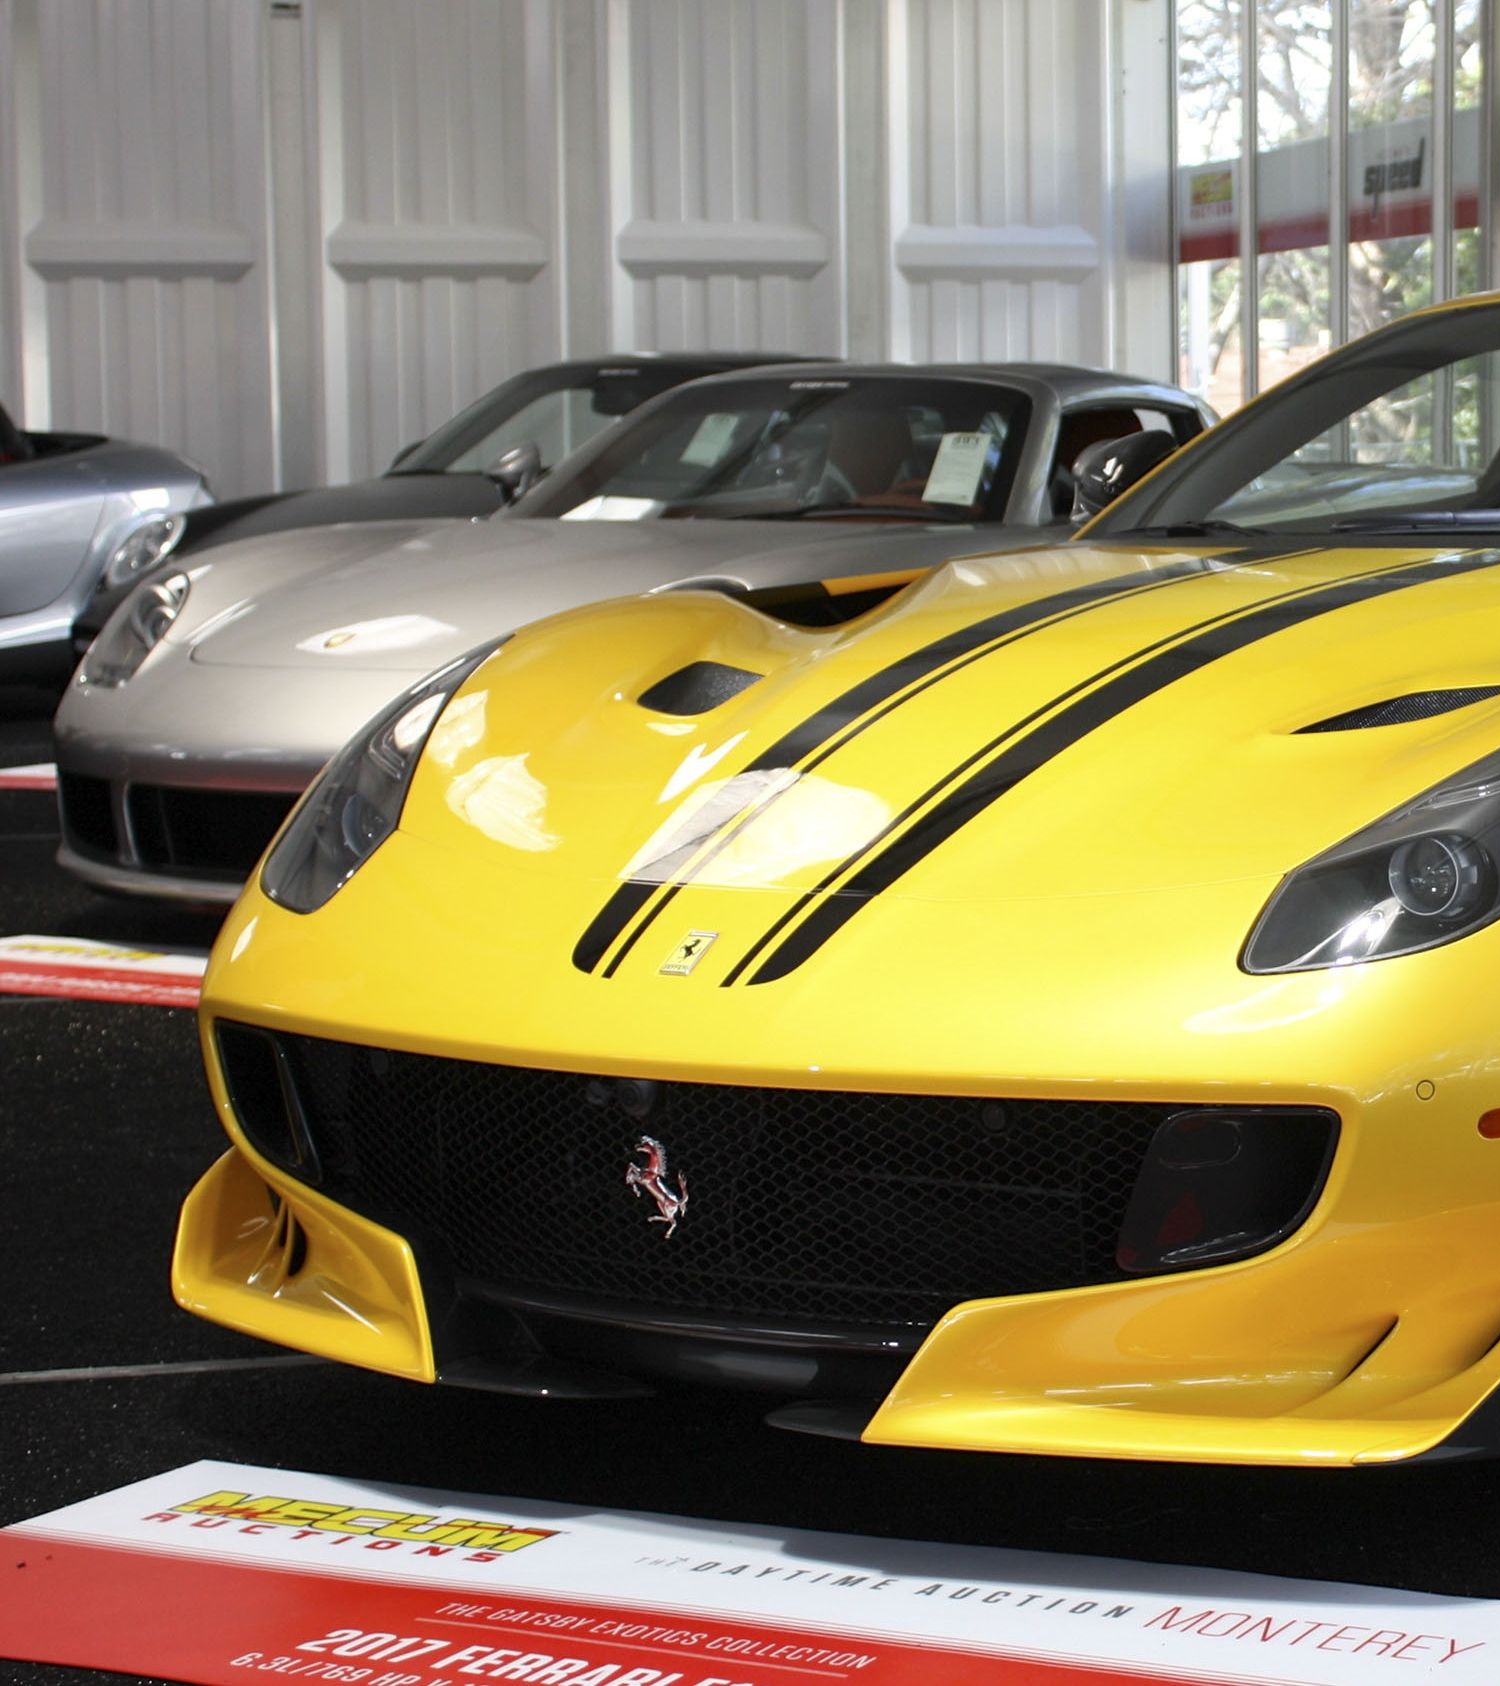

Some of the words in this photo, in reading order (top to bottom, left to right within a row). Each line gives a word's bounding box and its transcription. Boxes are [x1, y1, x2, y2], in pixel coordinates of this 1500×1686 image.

[143, 1511, 505, 1563] AUCTIONS
[168, 1490, 560, 1553] MECUM
[435, 1602, 492, 1618] THE
[487, 1608, 595, 1631] GATSBY
[589, 1620, 709, 1647] EXOTICS
[705, 1636, 877, 1669] COLLECTION
[689, 1561, 899, 1590] DAYTIME
[914, 1583, 1134, 1618] AUCTION
[1143, 1606, 1486, 1664] MONTEREY
[229, 1652, 374, 1683] 6.3L/769
[368, 1672, 422, 1686] HP
[295, 1629, 452, 1663] 2017
